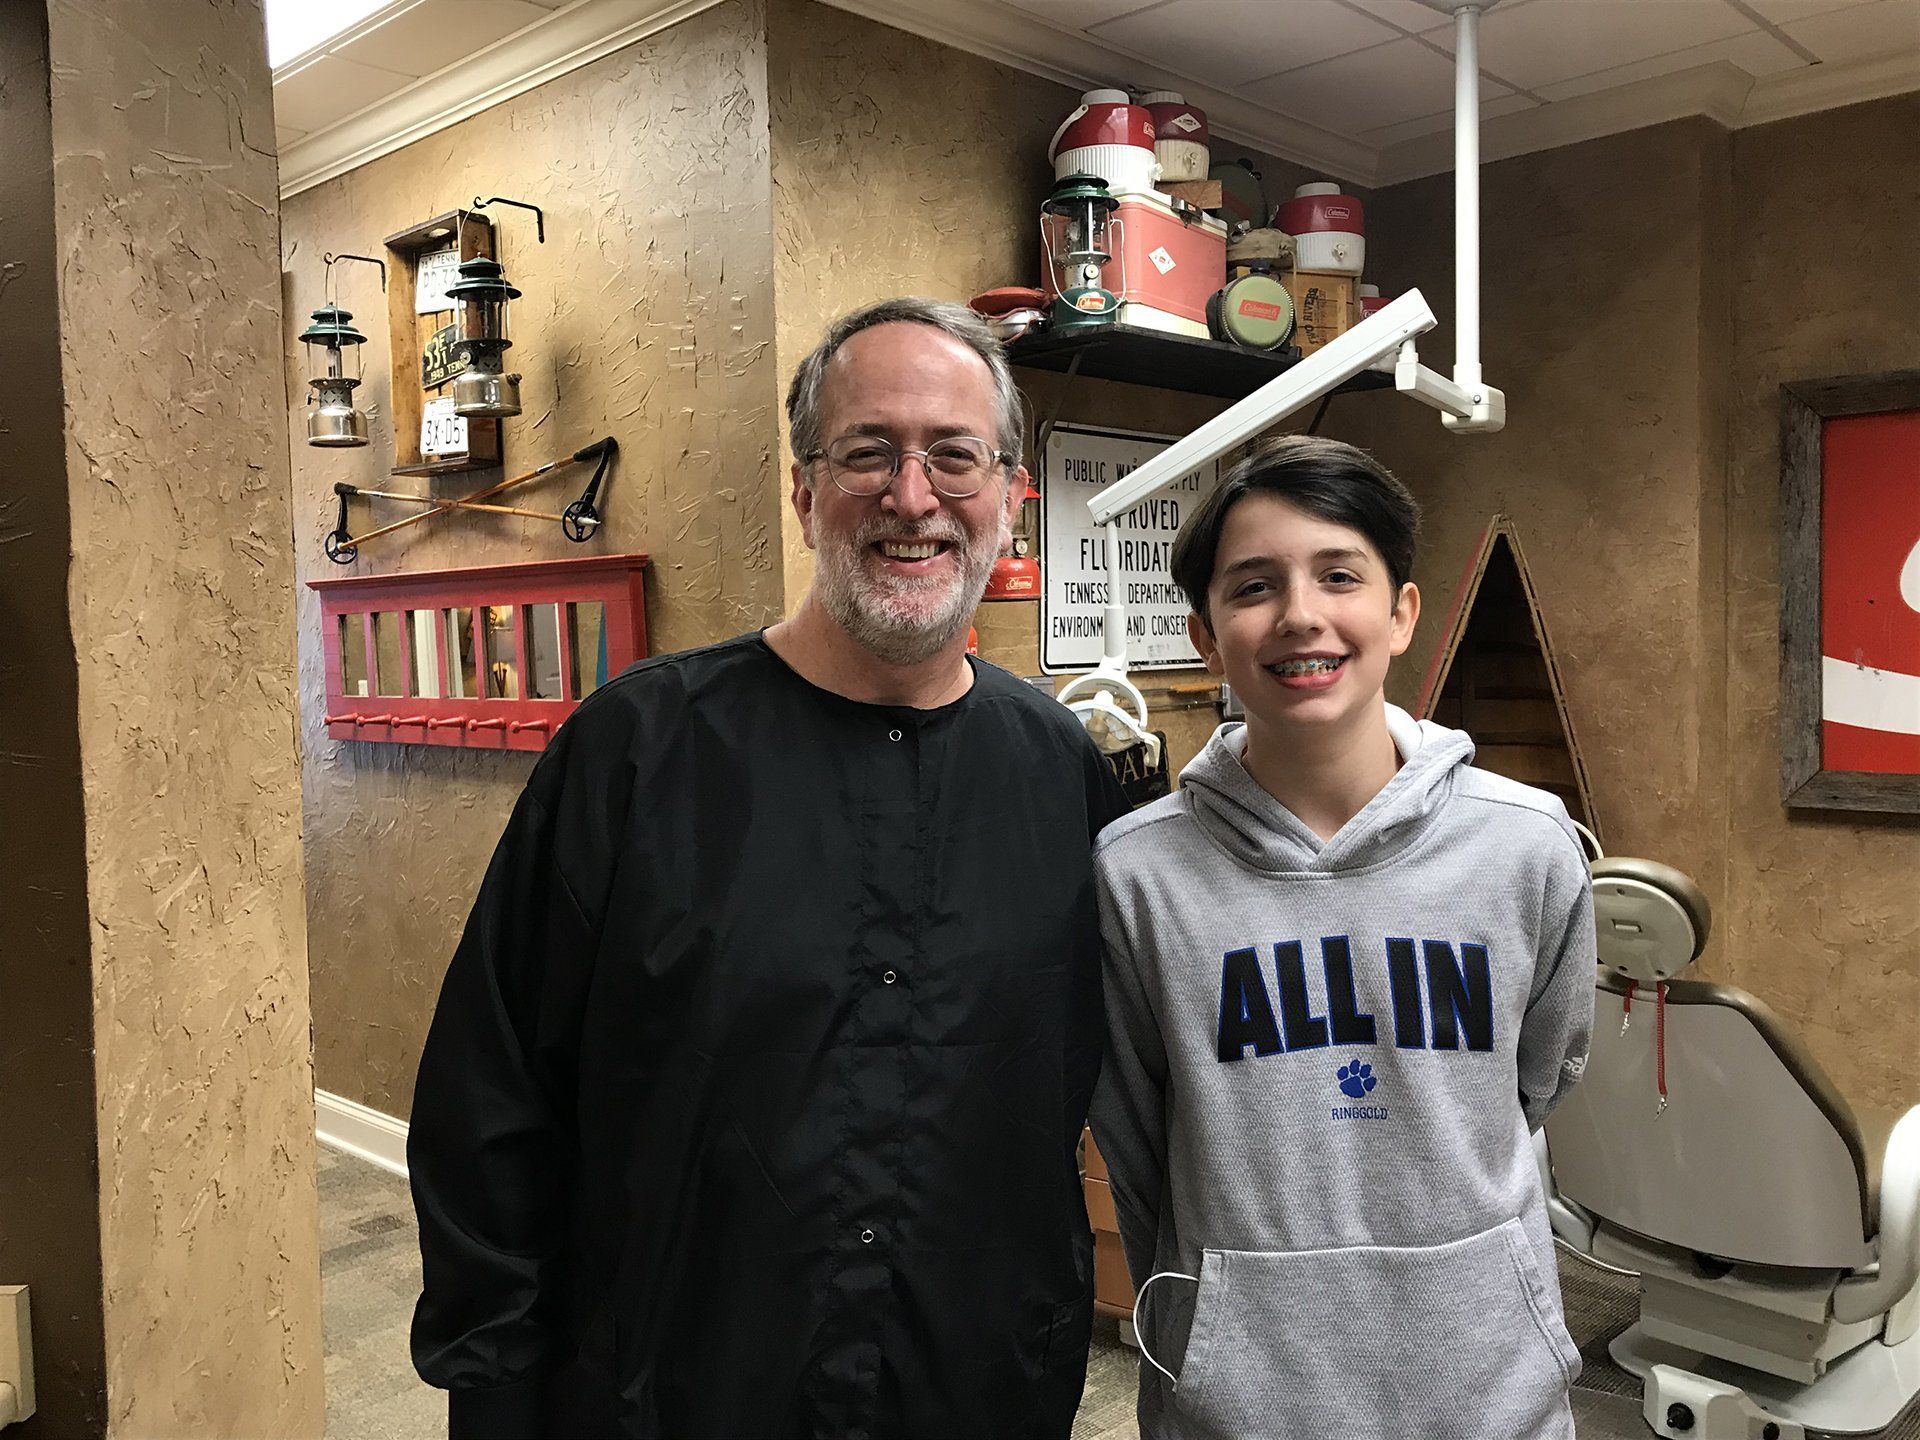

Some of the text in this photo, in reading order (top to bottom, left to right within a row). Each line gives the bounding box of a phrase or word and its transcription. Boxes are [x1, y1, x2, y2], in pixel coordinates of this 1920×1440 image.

[1064, 458, 1106, 484] PUBLIC
[1064, 582, 1109, 604] TENNESS
[1053, 615, 1187, 638] ENVIRONM AND CONSER
[1217, 934, 1494, 1063] ALL IN
[1331, 1106, 1388, 1120] RINGGOLD
